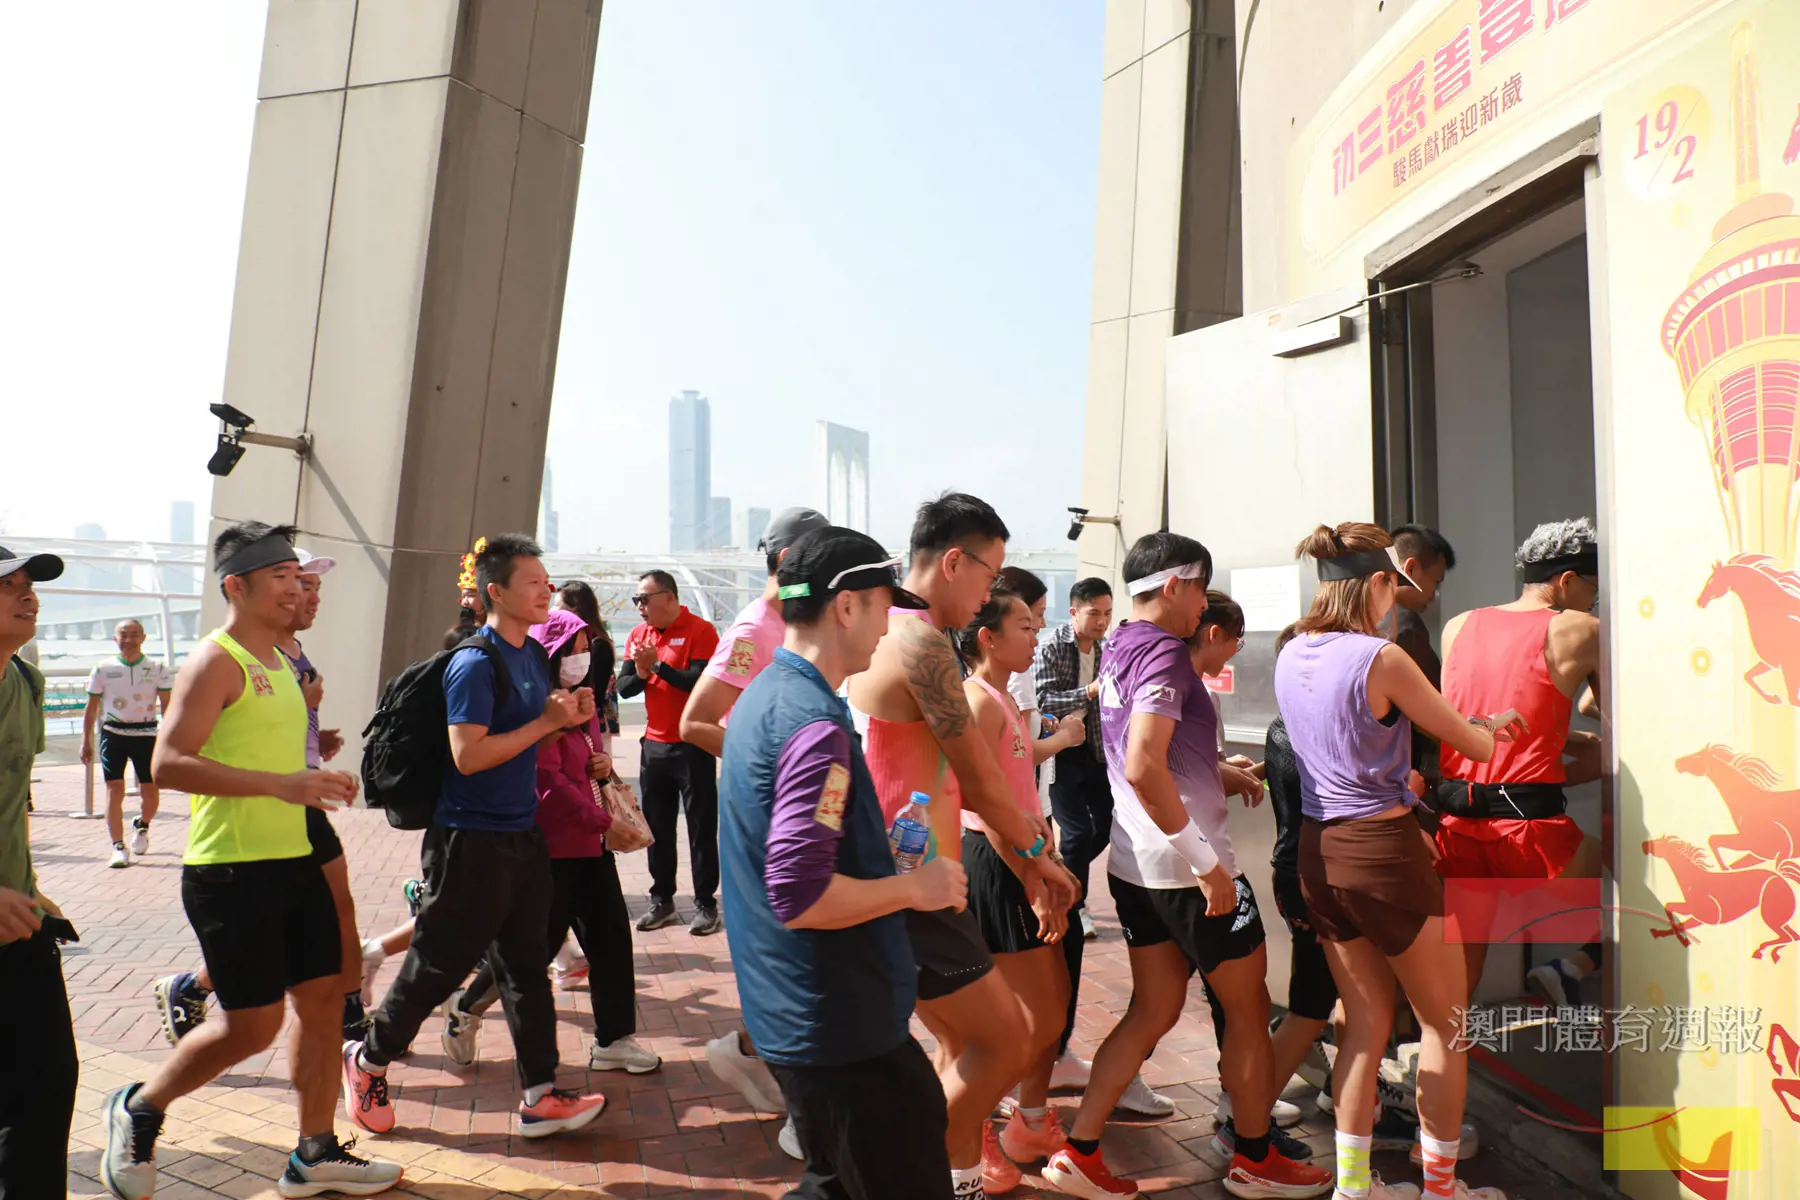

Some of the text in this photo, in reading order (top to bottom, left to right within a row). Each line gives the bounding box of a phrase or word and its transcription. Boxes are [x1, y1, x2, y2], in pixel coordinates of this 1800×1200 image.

[1333, 0, 1591, 196] 初三慈善登
[1393, 71, 1523, 188] 駿馬獻瑞迎新歲
